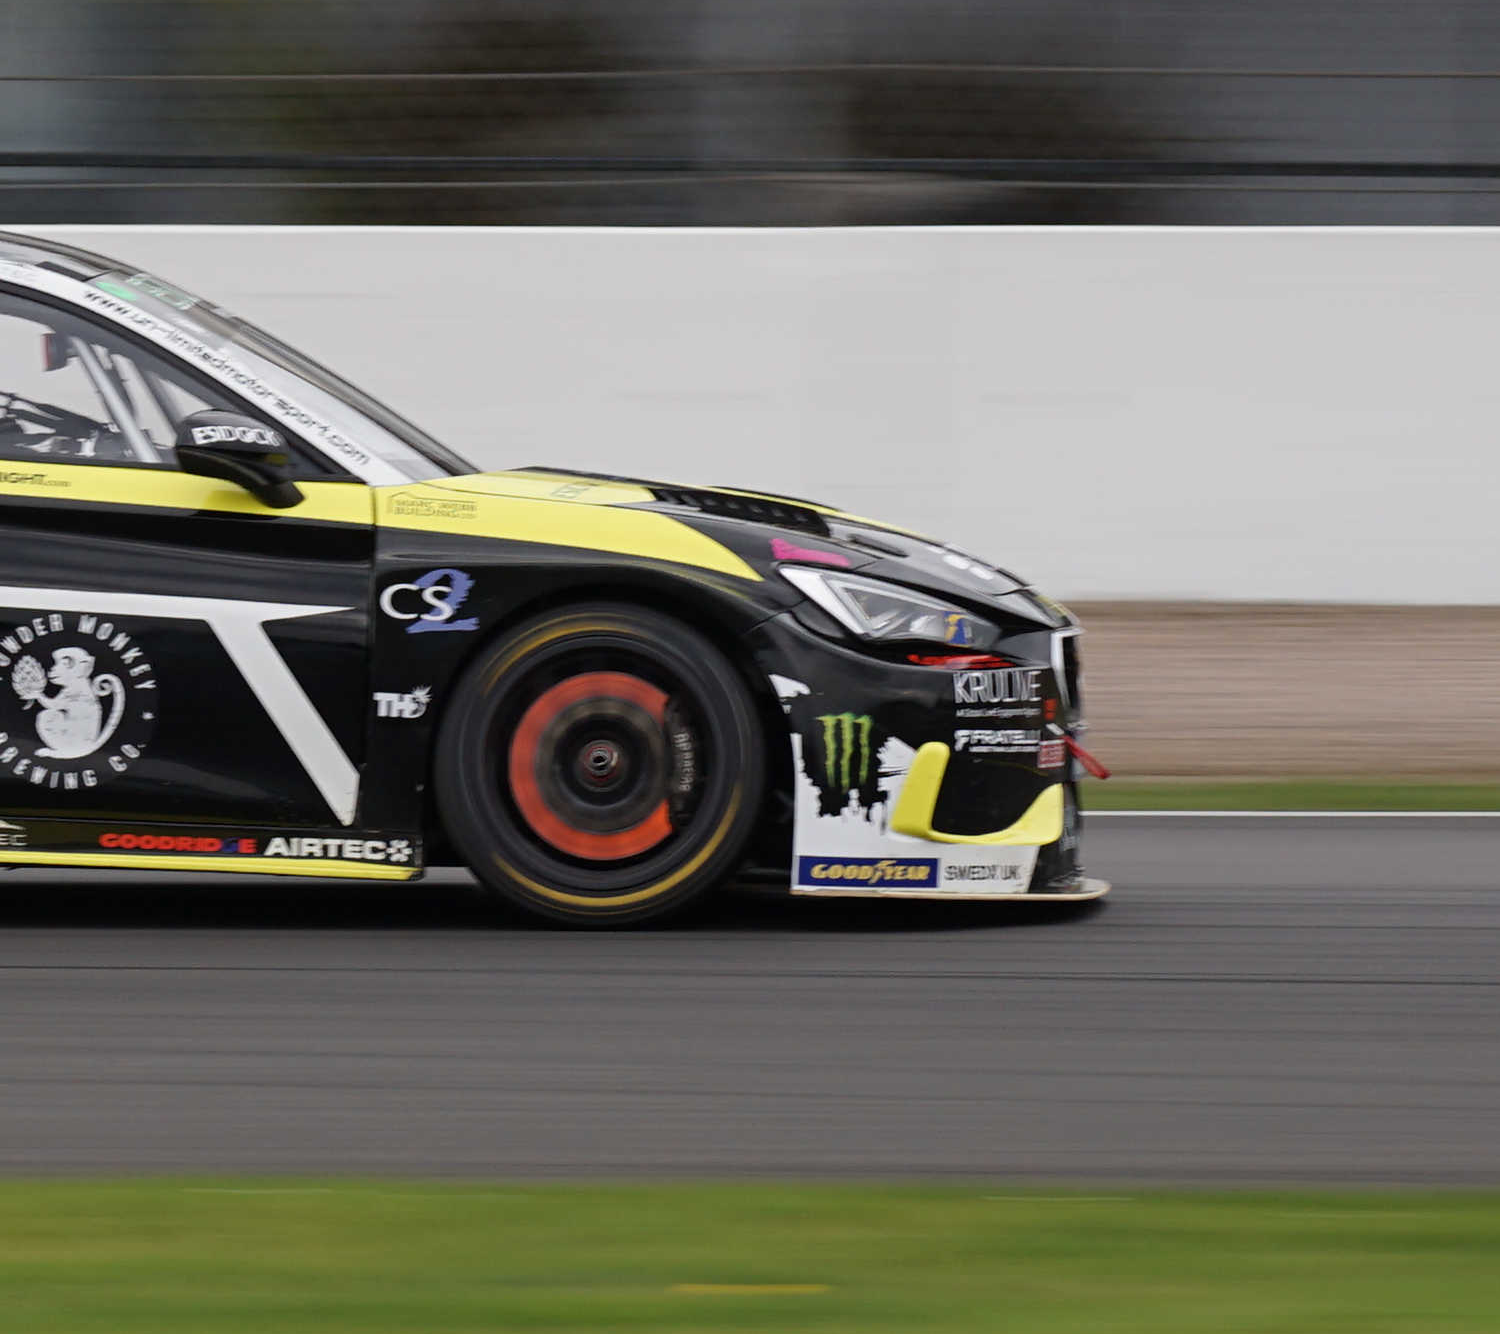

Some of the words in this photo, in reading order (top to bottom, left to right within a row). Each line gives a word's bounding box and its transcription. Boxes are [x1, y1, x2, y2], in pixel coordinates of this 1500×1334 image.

[76, 614, 158, 691] MONKEY
[99, 832, 257, 855] GOODRIDGE
[264, 836, 387, 860] AIRTEC
[810, 860, 931, 884] GOODYEAR
